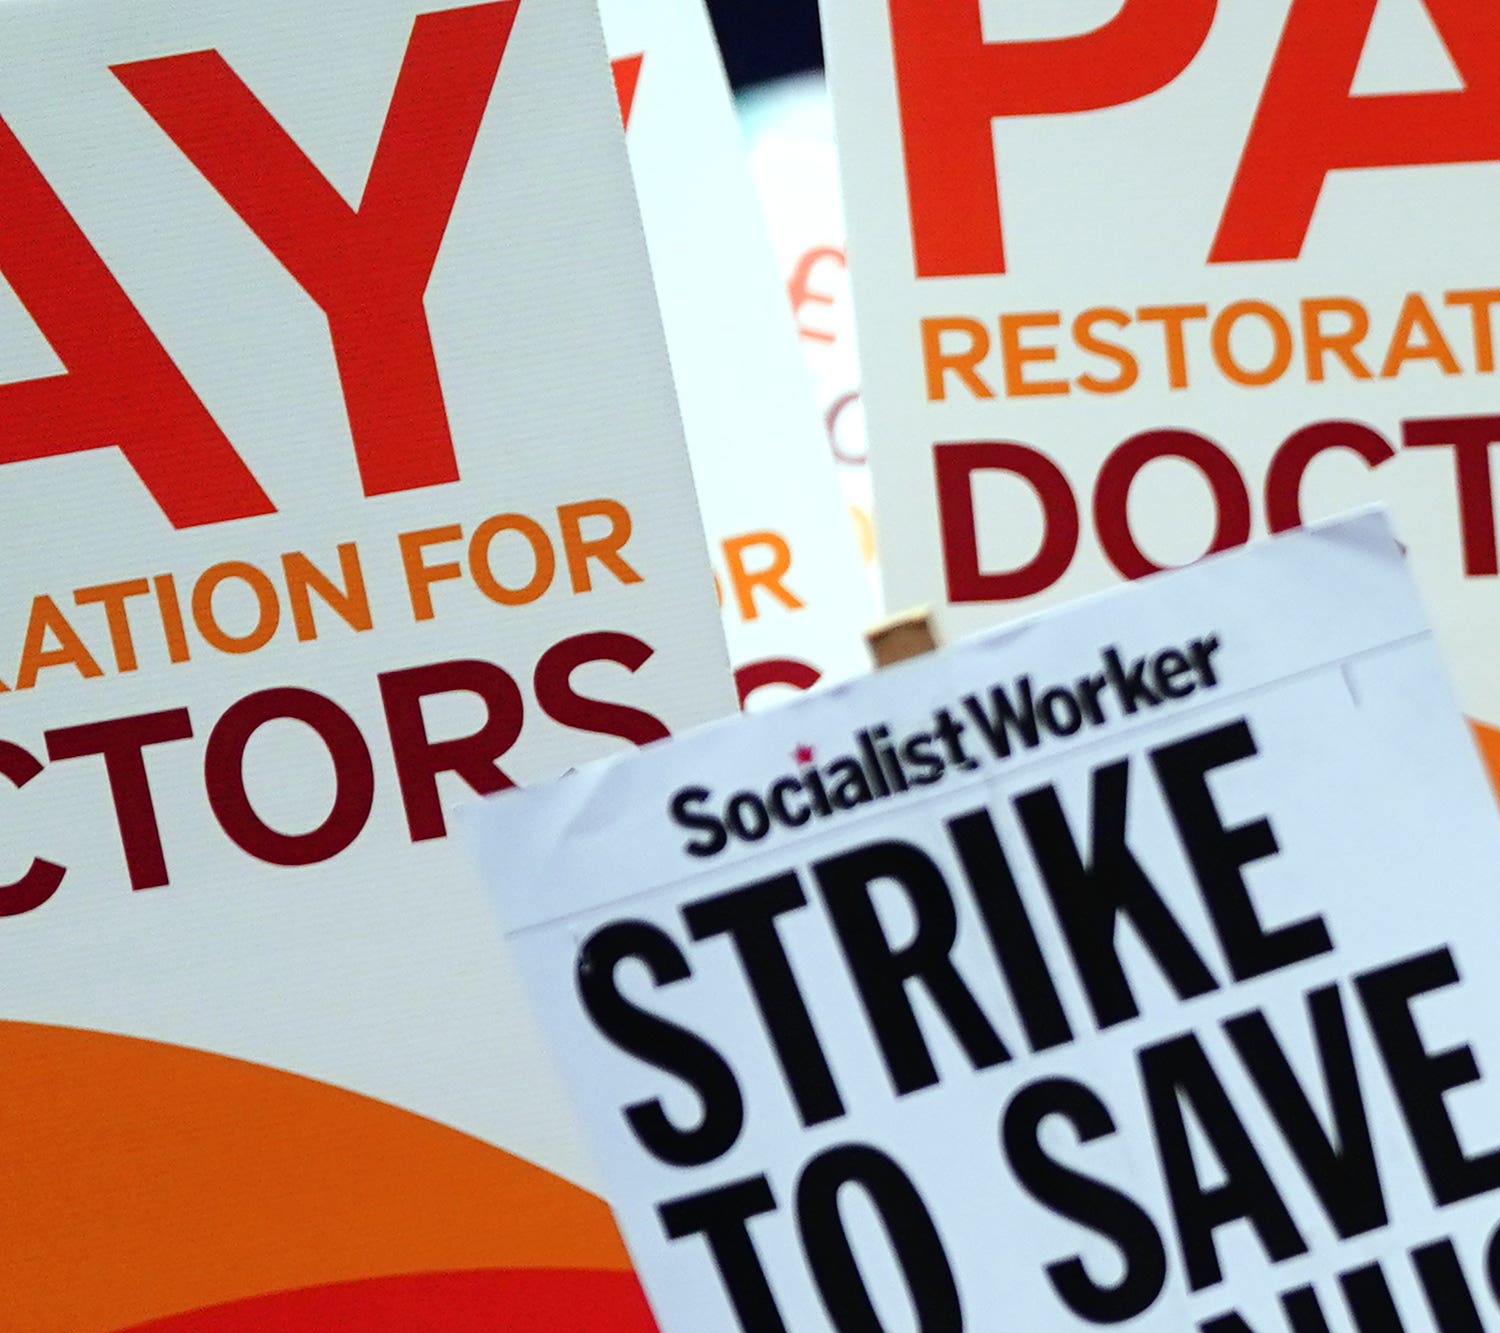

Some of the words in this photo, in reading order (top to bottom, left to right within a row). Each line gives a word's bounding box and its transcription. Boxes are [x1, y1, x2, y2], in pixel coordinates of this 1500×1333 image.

[0, 543, 373, 692] ATION
[399, 498, 644, 622] FOR
[669, 715, 980, 857] Socialist
[966, 631, 1222, 760] Worker
[577, 716, 1334, 1168] STRIKE
